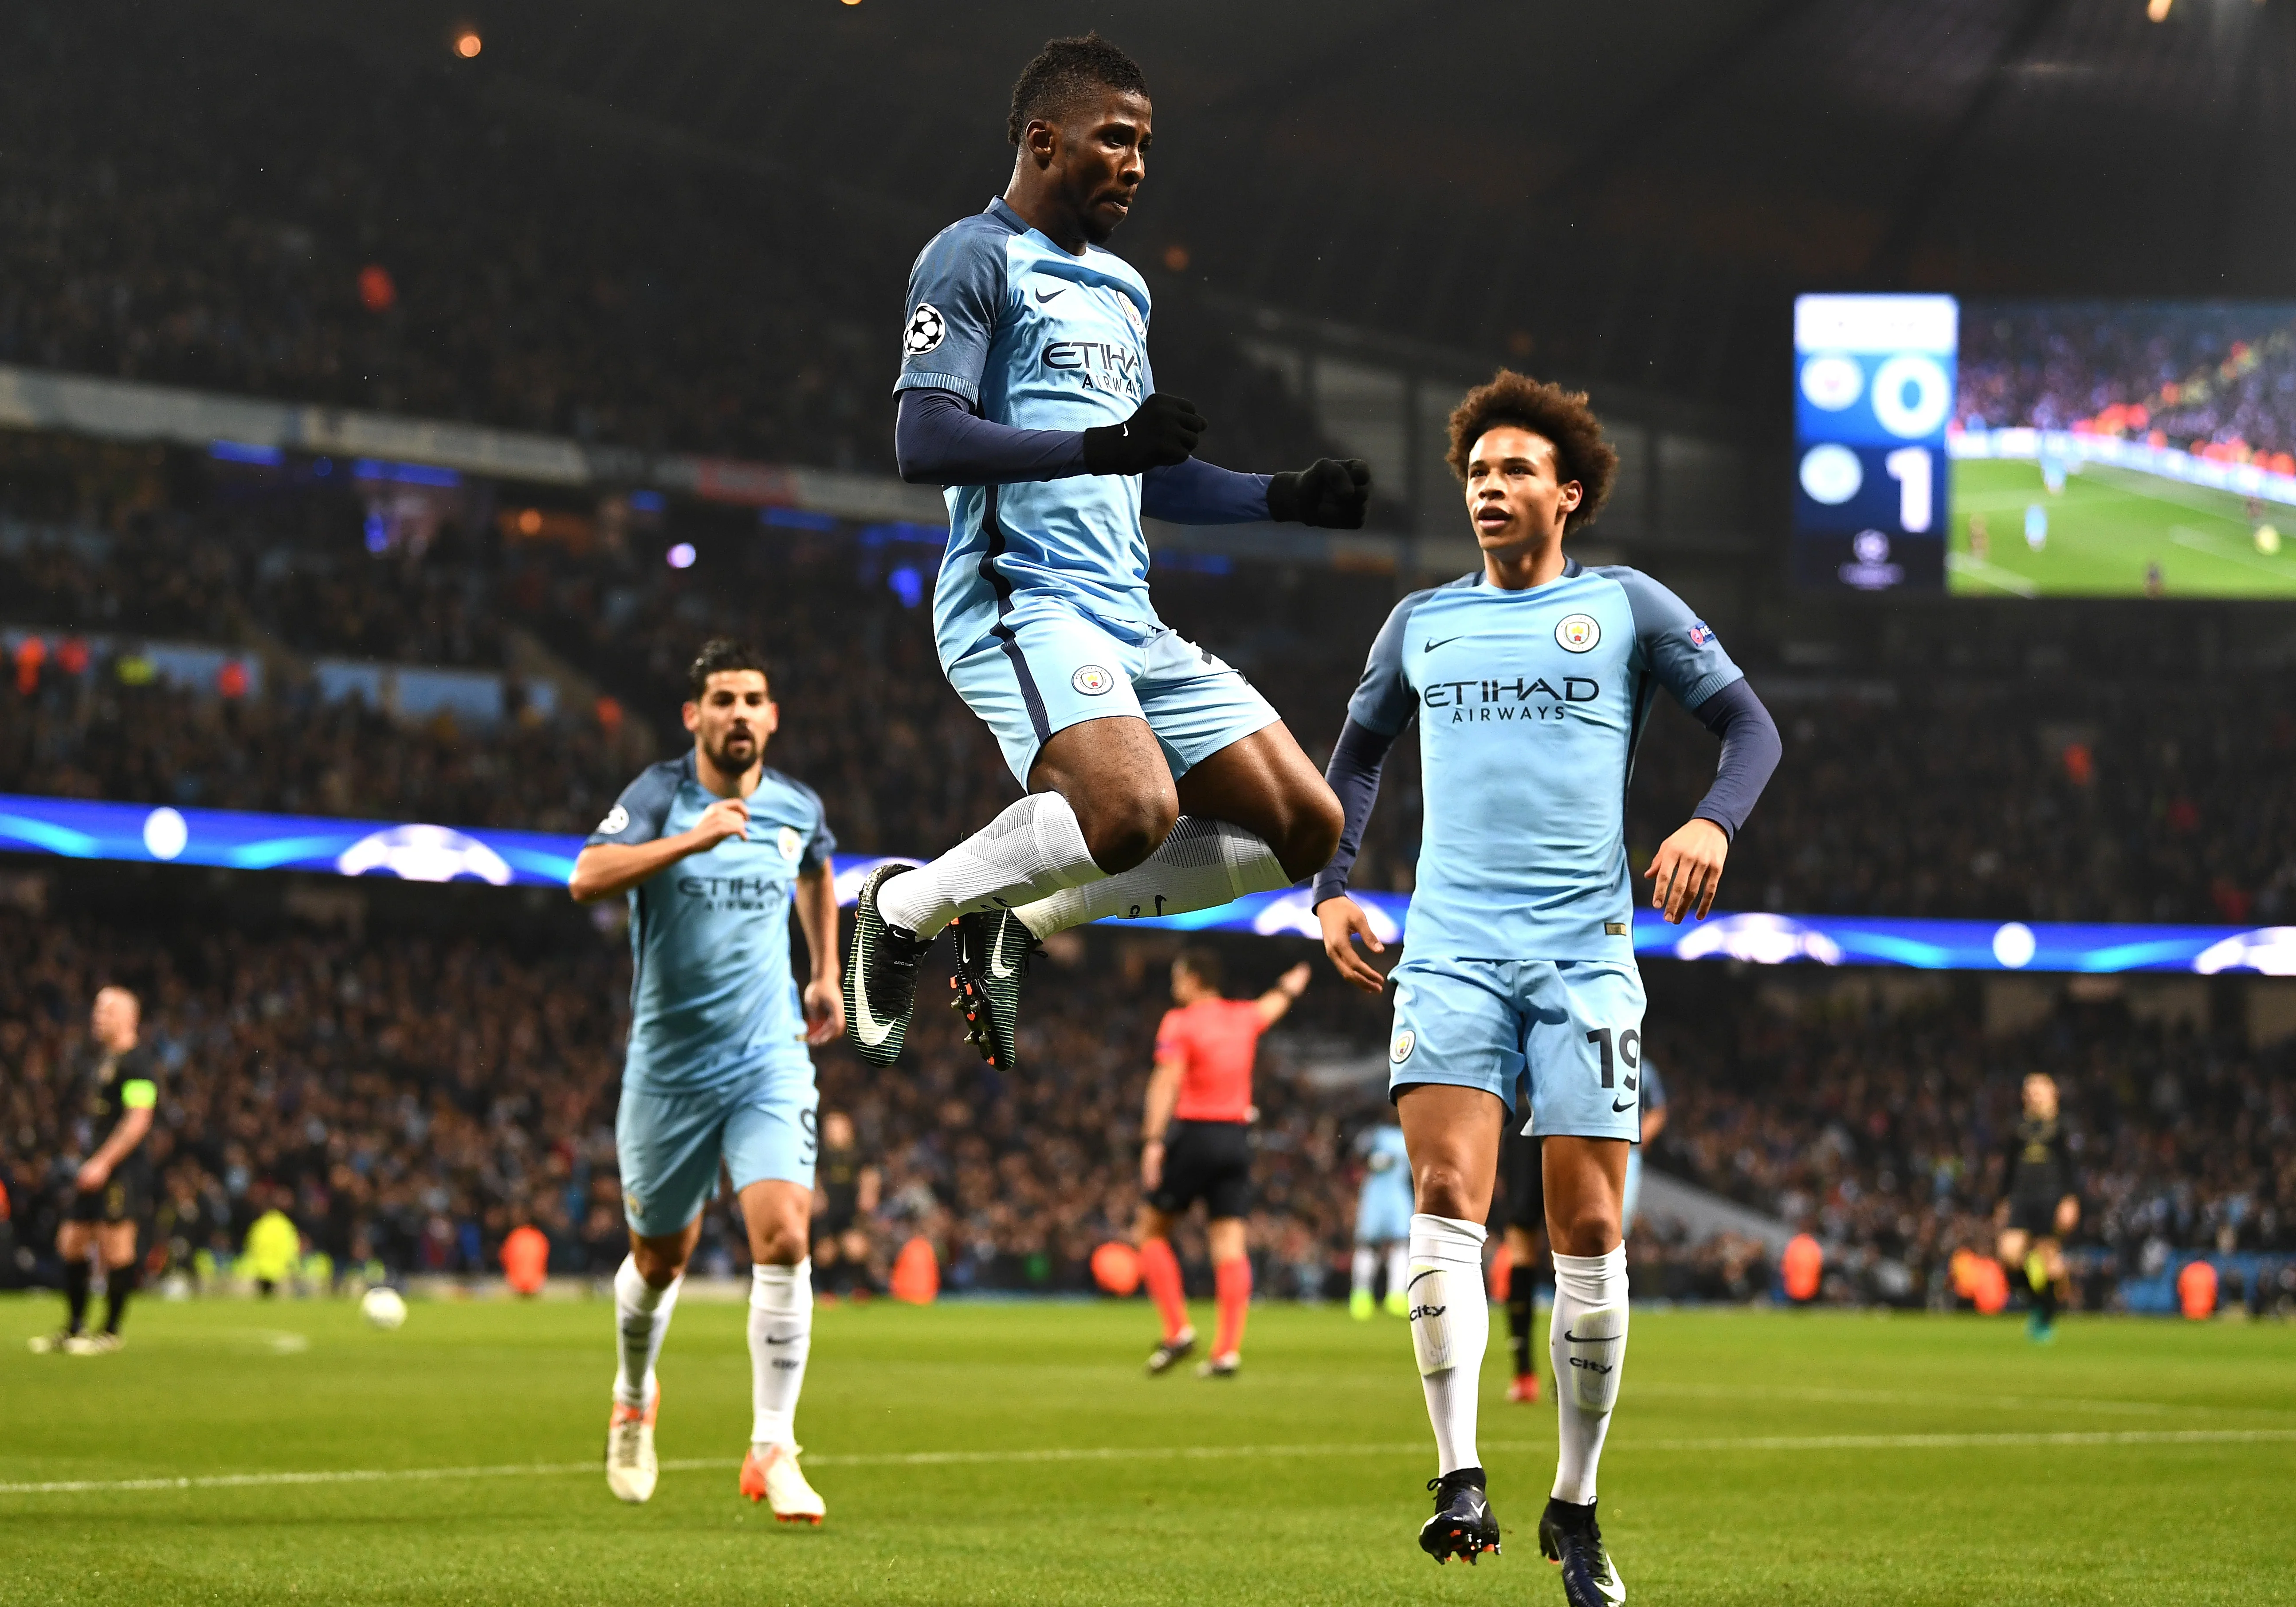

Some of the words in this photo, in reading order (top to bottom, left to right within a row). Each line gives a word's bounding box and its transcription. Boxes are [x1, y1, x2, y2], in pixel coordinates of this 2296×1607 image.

[1042, 342, 1140, 373] ETIHA
[1082, 373, 1141, 394] AIRWA
[1871, 354, 1950, 438] 0
[1885, 445, 1933, 532] 1
[1425, 677, 1599, 707] ETIHAD
[1452, 706, 1564, 723] AIRWAYS
[678, 876, 786, 897] ETIHA
[1586, 1028, 1638, 1091] 19
[1409, 1304, 1446, 1321] city
